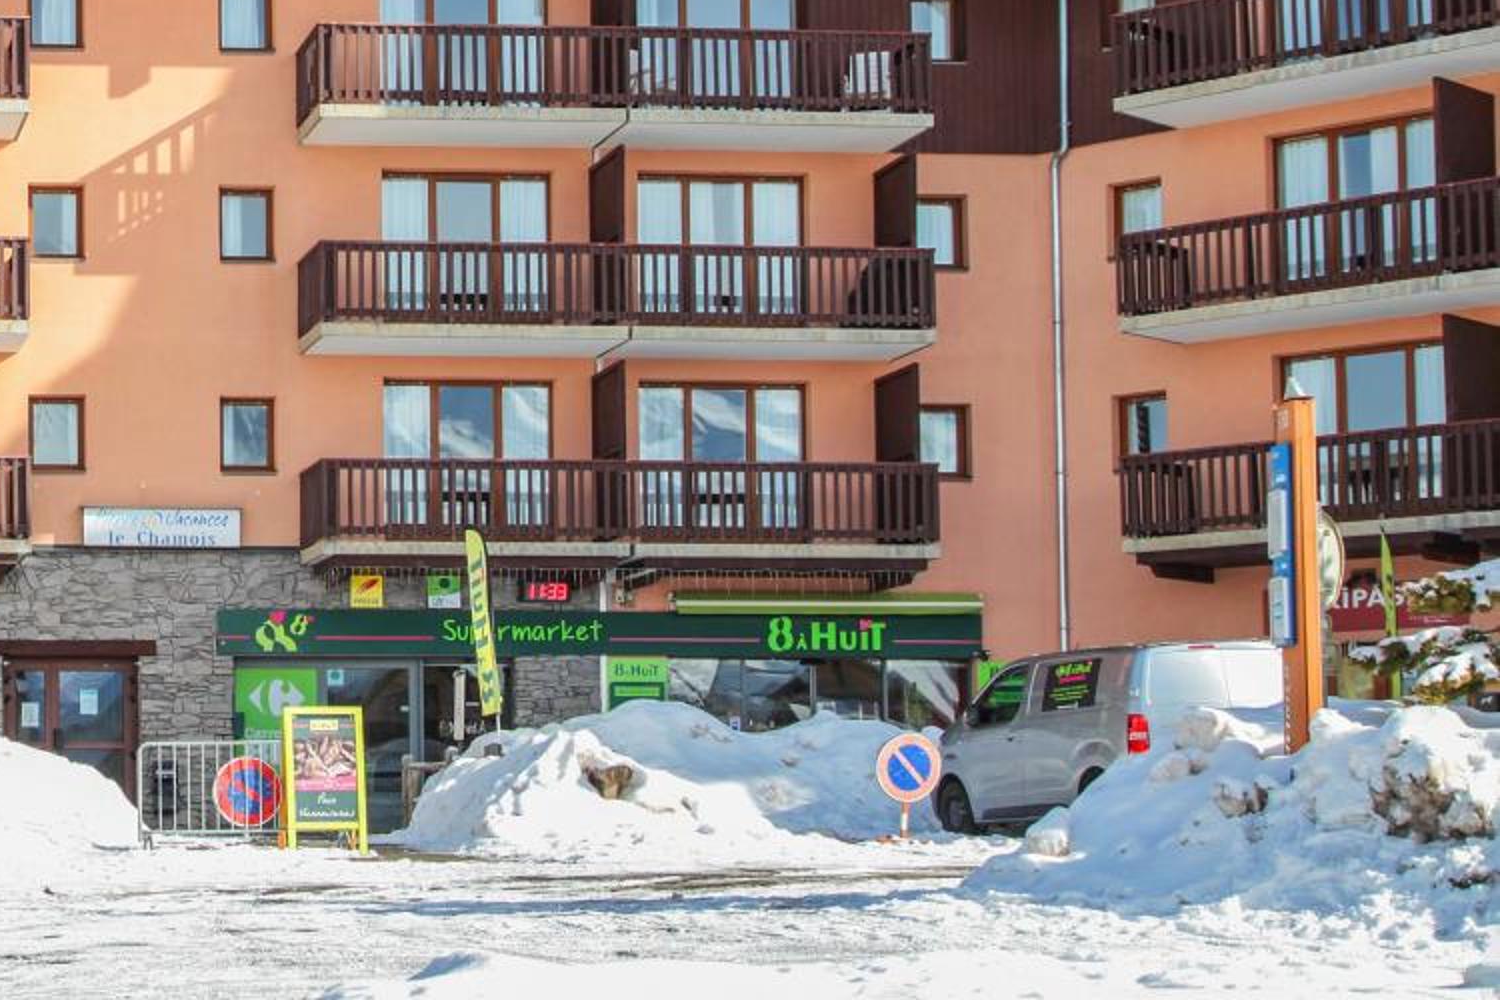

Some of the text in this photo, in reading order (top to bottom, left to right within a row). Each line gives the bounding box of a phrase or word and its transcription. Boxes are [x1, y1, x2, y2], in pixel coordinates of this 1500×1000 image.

[137, 530, 216, 546] Chamois
[442, 619, 603, 645] Surmarket
[767, 616, 794, 652] 8
